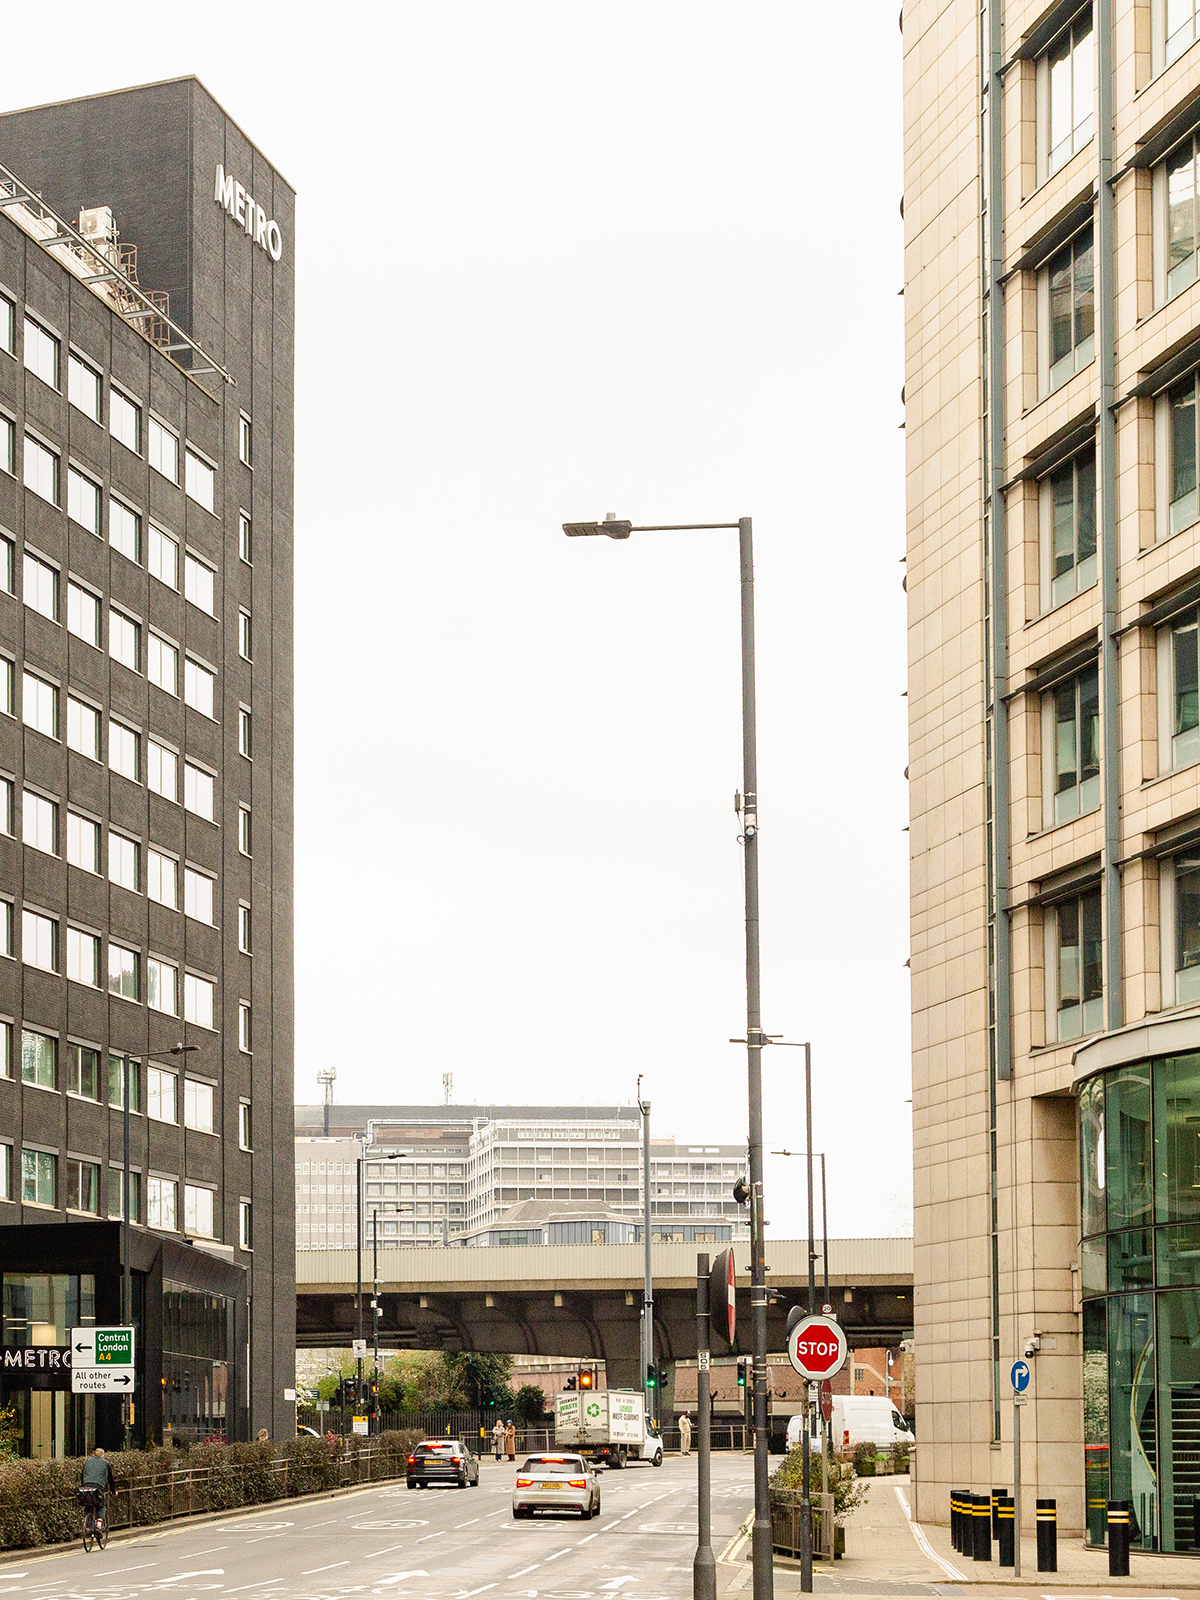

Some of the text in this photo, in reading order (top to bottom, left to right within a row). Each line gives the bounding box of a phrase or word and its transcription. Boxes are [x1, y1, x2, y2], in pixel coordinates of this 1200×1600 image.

[214, 163, 283, 262] METRO
[98, 1333, 130, 1342] Central
[98, 1343, 128, 1351] London
[798, 1341, 838, 1356] STOP
[98, 1352, 112, 1361] A4
[75, 1372, 111, 1380] All other
[79, 1381, 107, 1389] routes
[560, 1402, 578, 1411] WASTE
